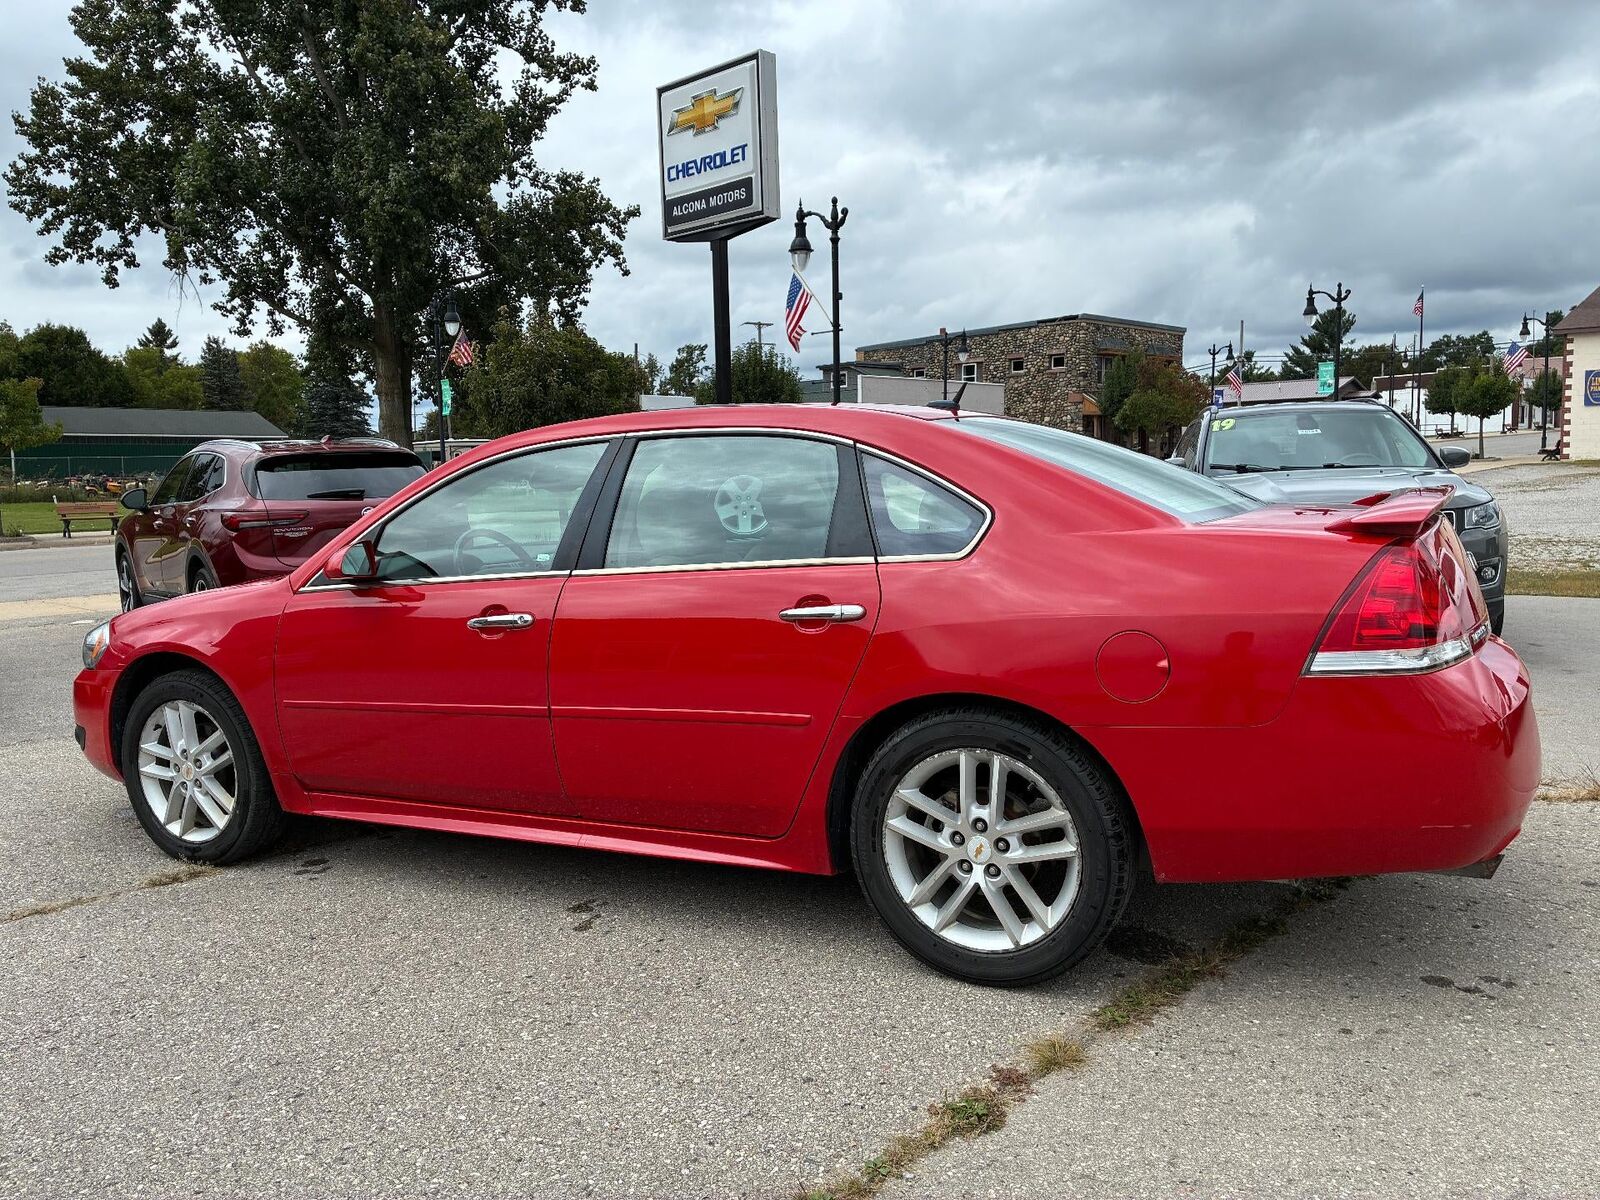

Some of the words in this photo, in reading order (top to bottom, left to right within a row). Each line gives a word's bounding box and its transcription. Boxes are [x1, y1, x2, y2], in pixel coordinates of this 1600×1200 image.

[667, 143, 748, 182] CHEVROLET
[672, 199, 706, 217] ALCONA
[709, 188, 746, 208] MOTORS
[1212, 418, 1235, 432] 19
